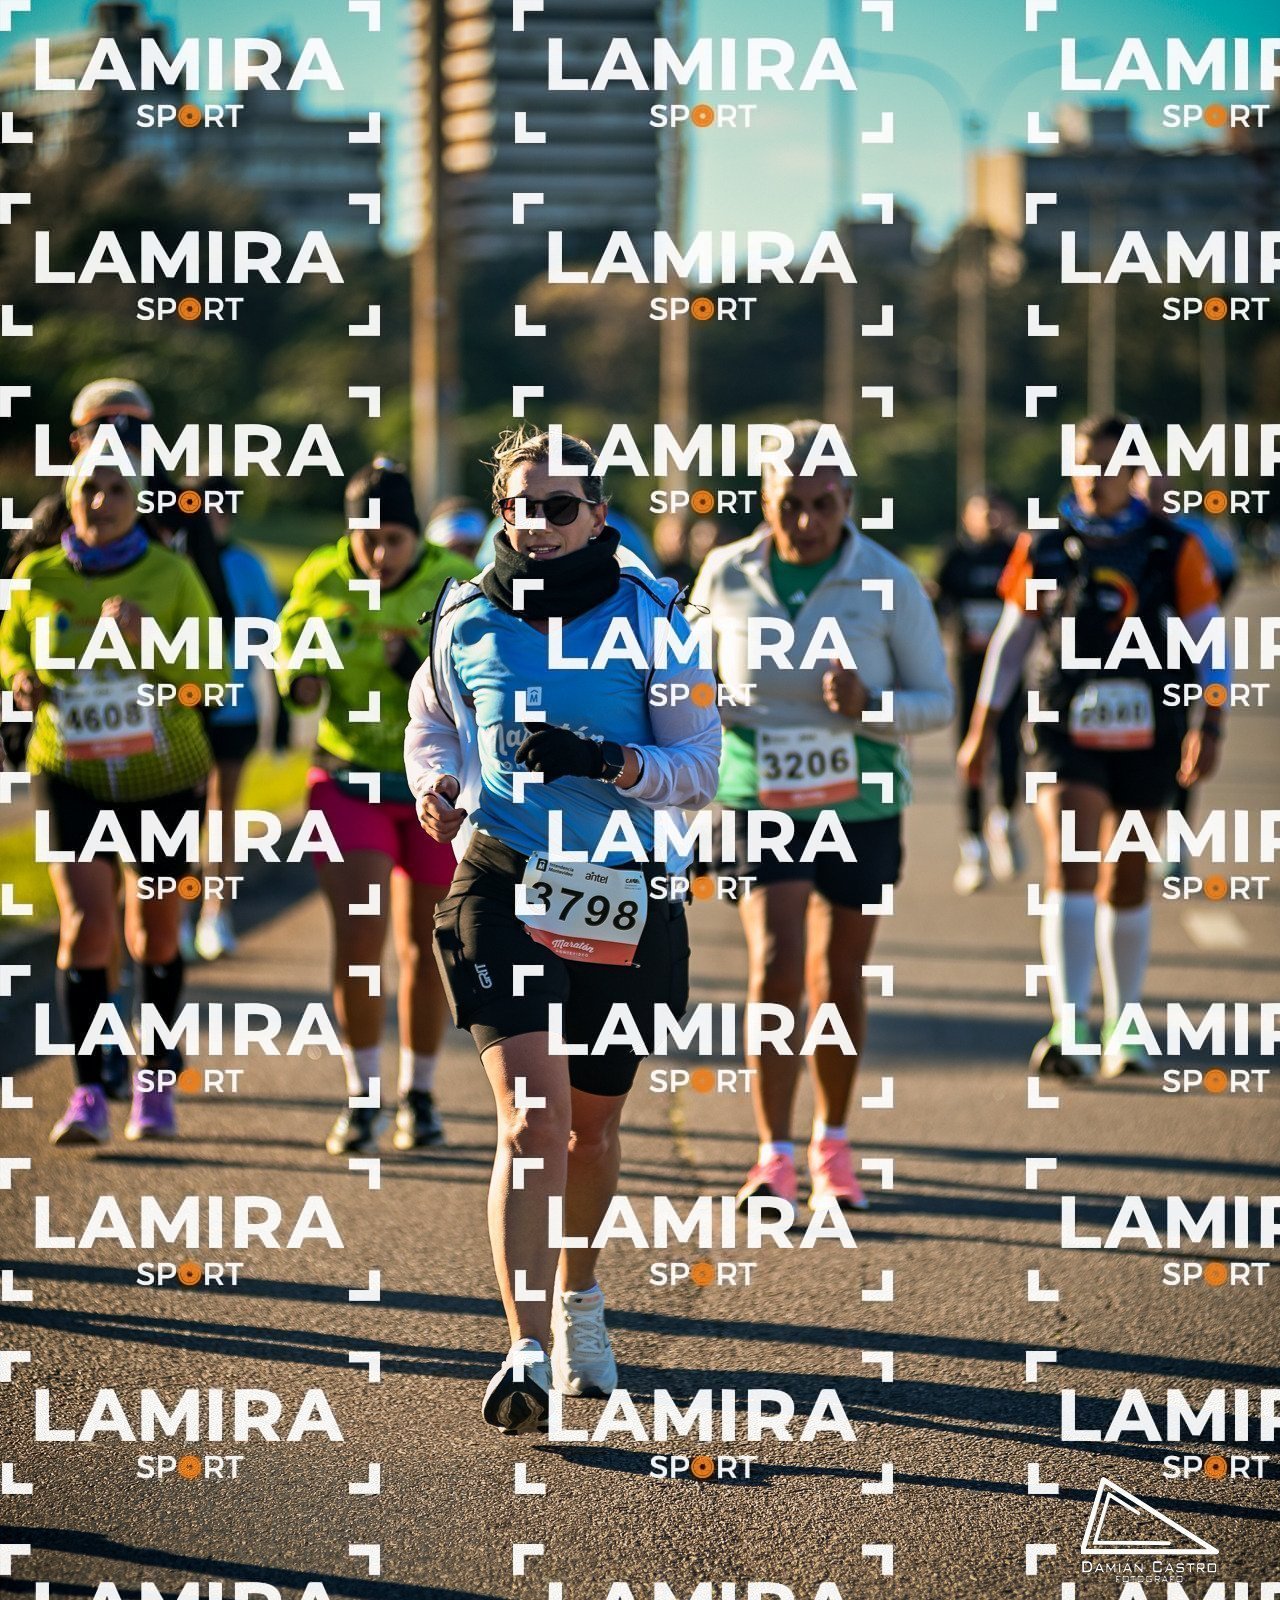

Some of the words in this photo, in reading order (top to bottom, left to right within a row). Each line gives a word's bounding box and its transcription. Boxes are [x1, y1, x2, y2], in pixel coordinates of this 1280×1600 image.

[65, 701, 144, 733] 4608
[763, 747, 849, 780] 3206
[585, 872, 608, 884] antel
[527, 881, 638, 931] 3798
[552, 939, 594, 953] Maratón
[474, 963, 493, 989] GRIT
